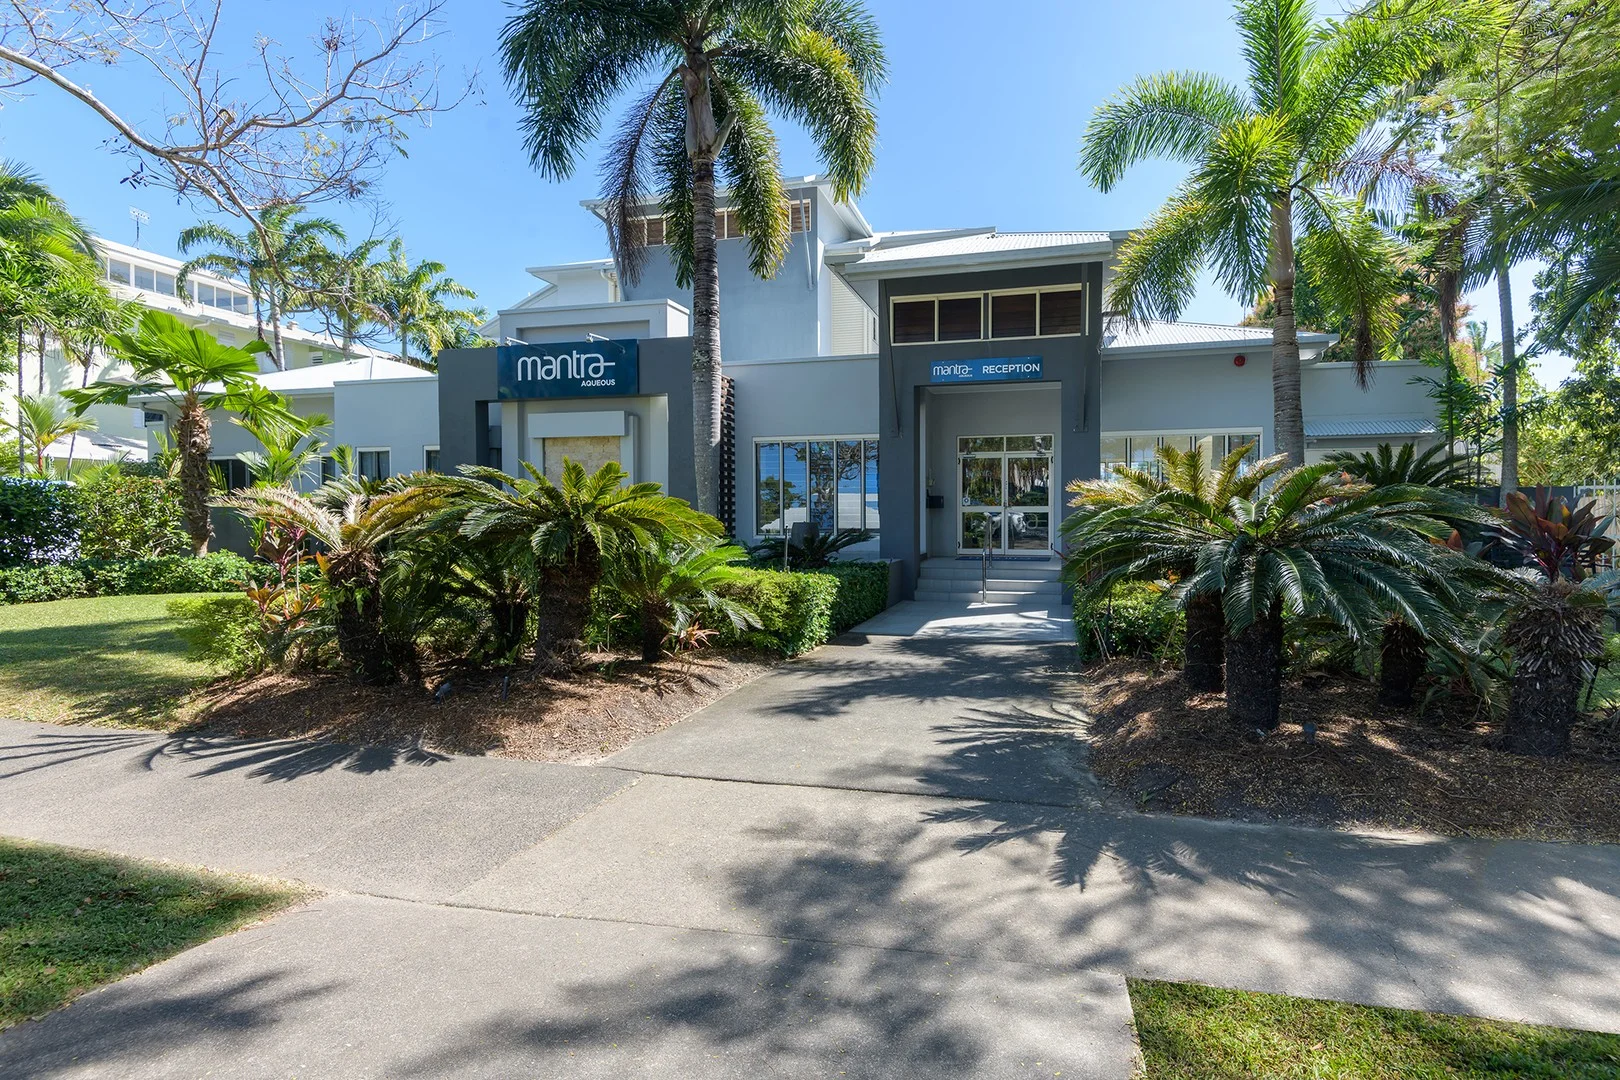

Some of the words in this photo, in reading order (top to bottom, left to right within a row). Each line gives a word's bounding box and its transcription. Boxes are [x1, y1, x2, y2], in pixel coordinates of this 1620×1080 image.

[517, 350, 615, 381] mantra
[933, 364, 973, 376] mantra
[982, 363, 1040, 374] RECEPTION
[581, 379, 616, 387] AQUEOUS
